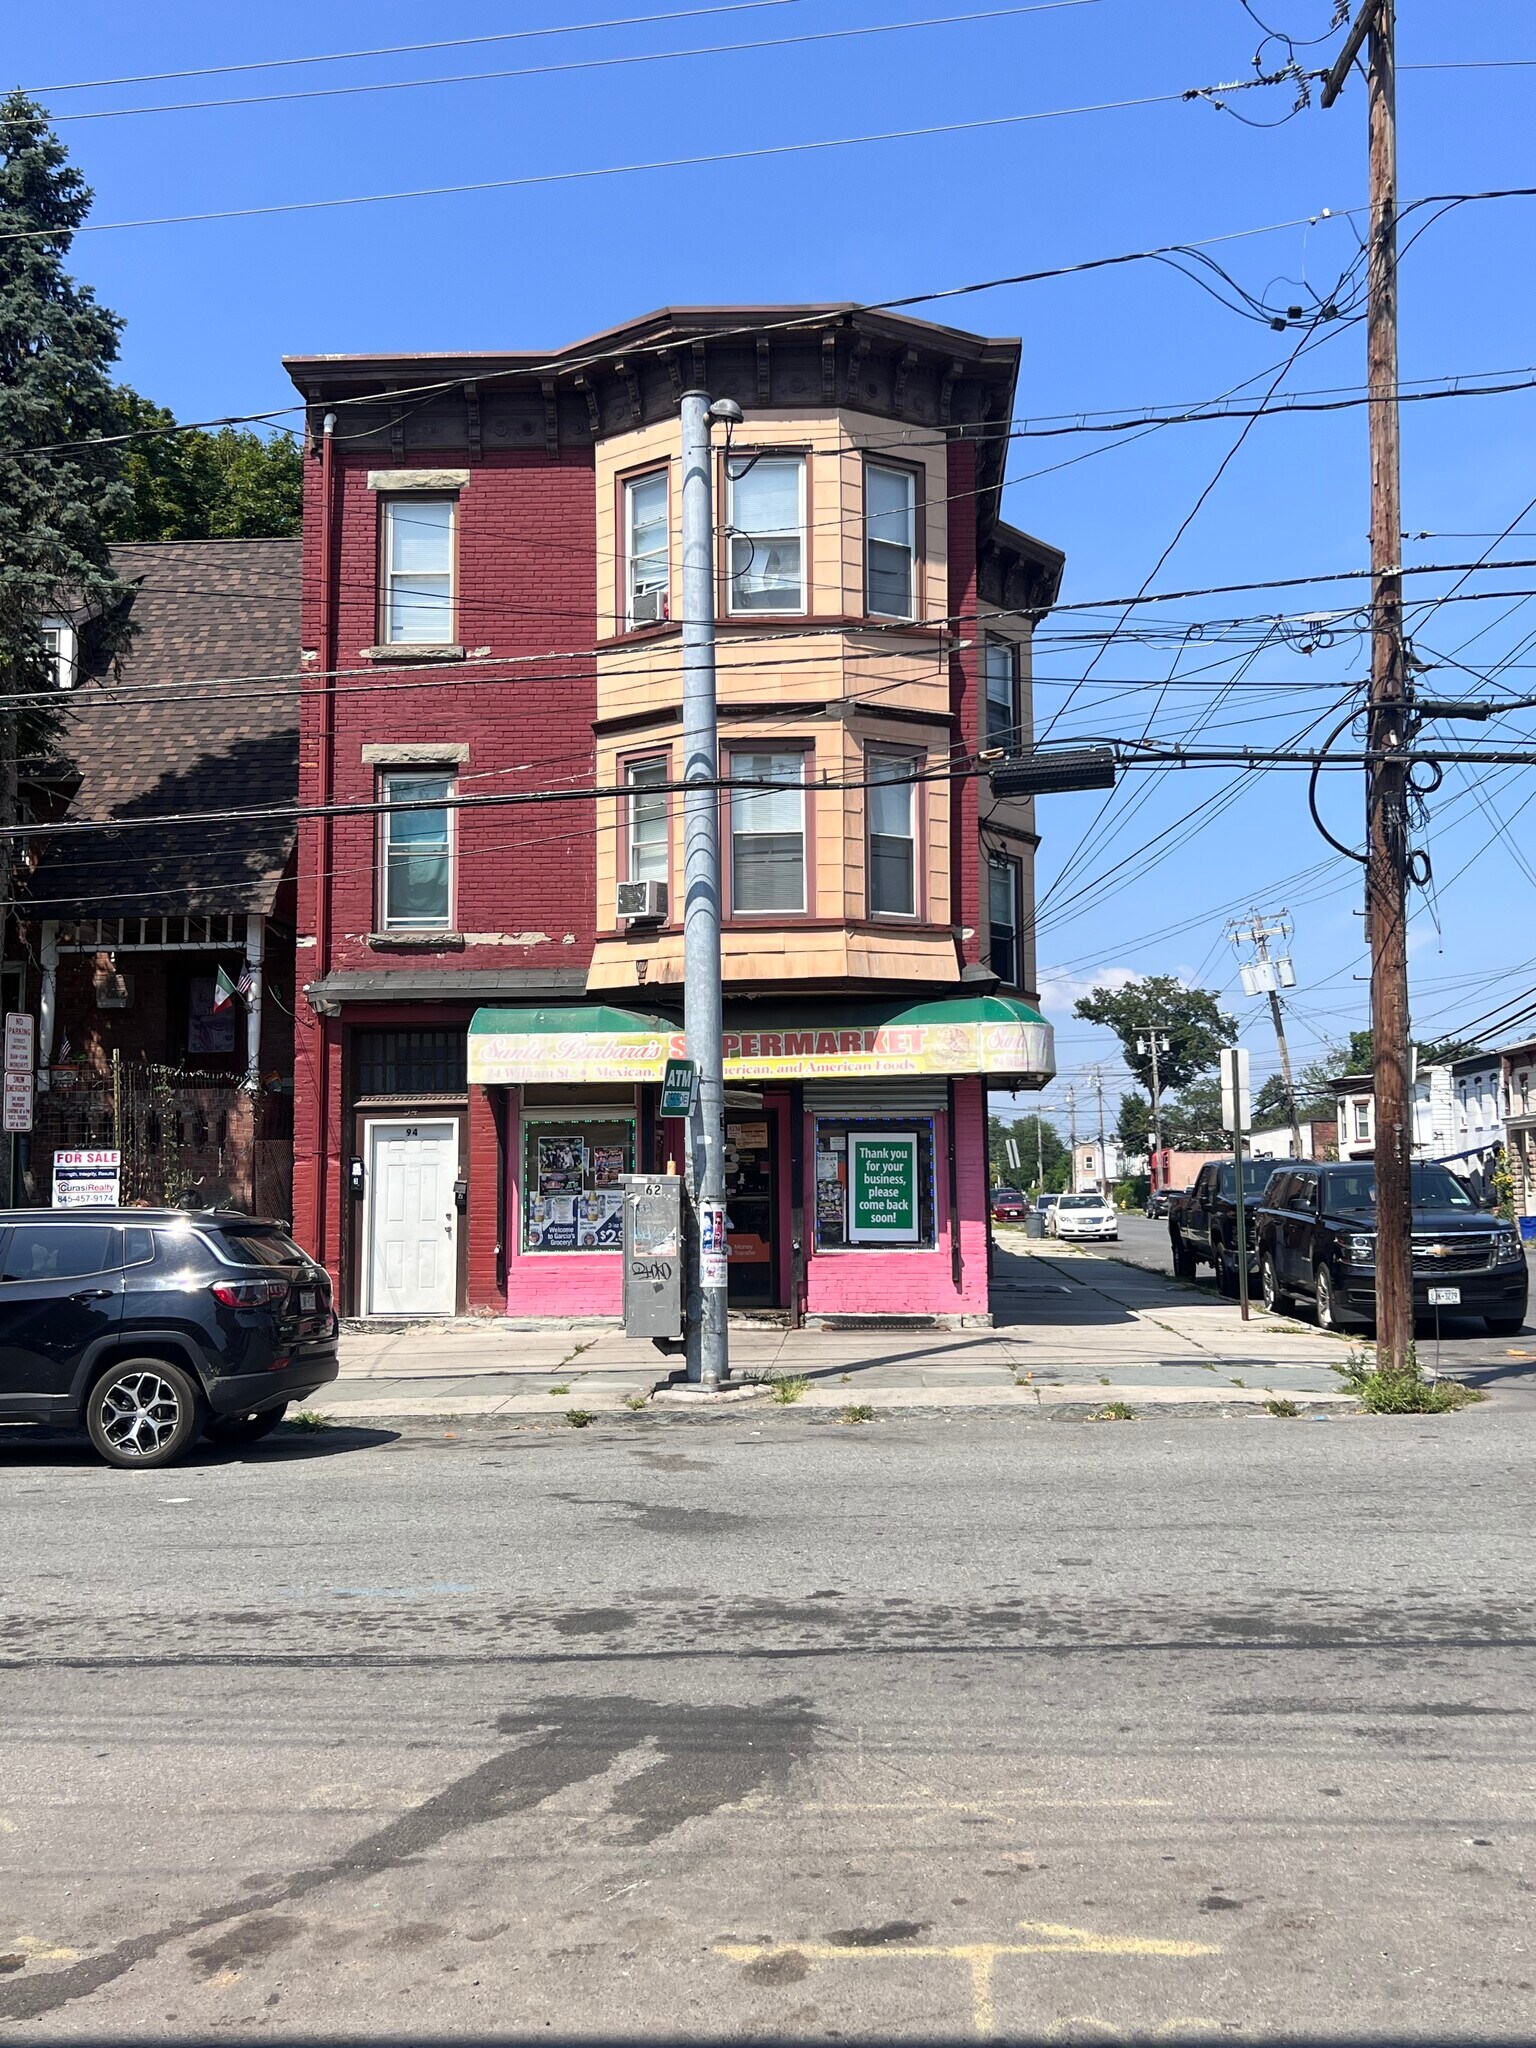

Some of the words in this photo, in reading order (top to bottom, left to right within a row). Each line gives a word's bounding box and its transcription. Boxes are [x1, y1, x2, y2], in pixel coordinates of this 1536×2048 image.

[8, 1026, 31, 1037] PARKING
[550, 1034, 662, 1061] Barbara's
[670, 1029, 925, 1058] SPERMARKET
[776, 1063, 803, 1074] and
[805, 1059, 872, 1073] American
[875, 1058, 916, 1072] Foods
[666, 1069, 692, 1088] ATM
[406, 1128, 418, 1137] 94
[56, 1153, 82, 1163] FOR
[87, 1152, 118, 1163] SALE
[859, 1148, 889, 1158] Thank
[890, 1150, 908, 1161] you
[866, 1160, 881, 1171] for
[882, 1163, 904, 1173] your
[864, 1173, 906, 1185] business,
[645, 1185, 661, 1195] 62
[868, 1186, 899, 1199] please
[57, 1194, 114, 1203] 845-457-9174
[859, 1201, 885, 1210] come
[886, 1199, 909, 1210] back
[871, 1212, 897, 1223] soon!
